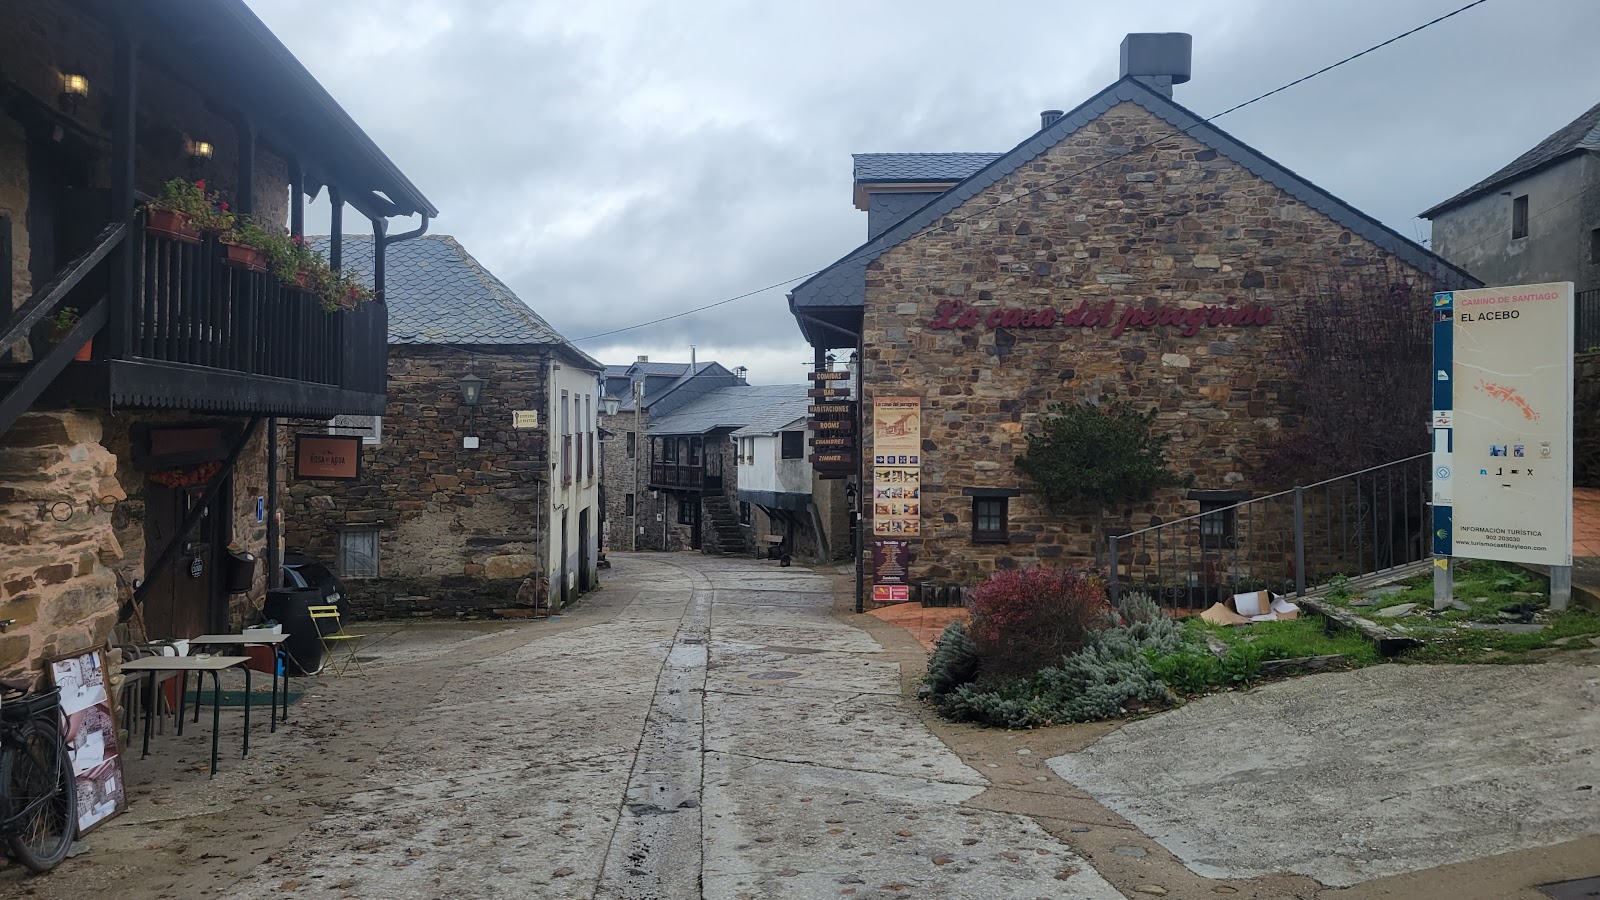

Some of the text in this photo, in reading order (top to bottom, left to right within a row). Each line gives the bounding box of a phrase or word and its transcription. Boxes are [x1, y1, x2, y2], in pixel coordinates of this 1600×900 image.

[1461, 292, 1559, 306] CAMINO DE SANTIAGO
[930, 296, 1274, 338] La casa del peregrino
[1461, 310, 1520, 322] EL ACEBO
[817, 372, 842, 380] COMIDAS
[809, 405, 849, 413] HABITACIONES
[331, 456, 346, 465] AGUA
[1460, 526, 1542, 537] INFORMACIÓN TURÍSTICA
[1455, 540, 1547, 551] www.turismocastillayleon.com
